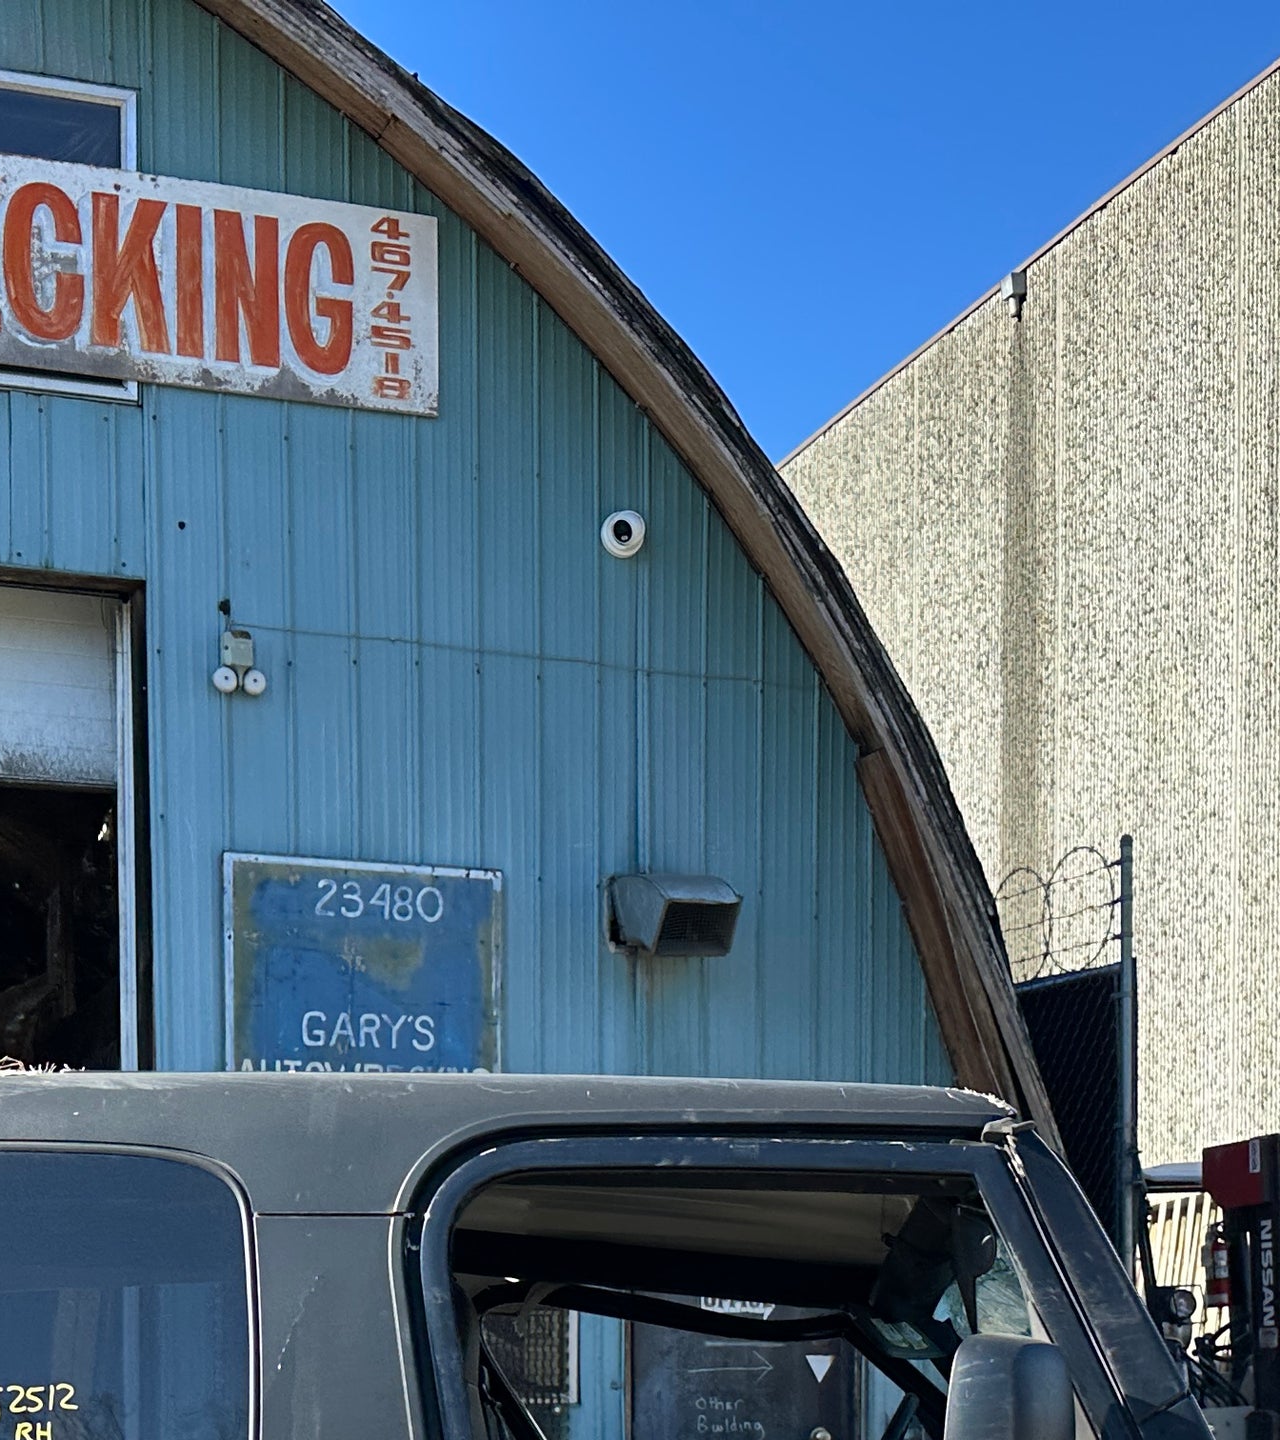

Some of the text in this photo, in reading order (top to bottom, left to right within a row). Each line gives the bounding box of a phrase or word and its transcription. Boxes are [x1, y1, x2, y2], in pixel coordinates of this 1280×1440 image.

[314, 878, 444, 923] 23480
[301, 1010, 436, 1051] GARY'S
[1260, 1219, 1276, 1326] NISSAN
